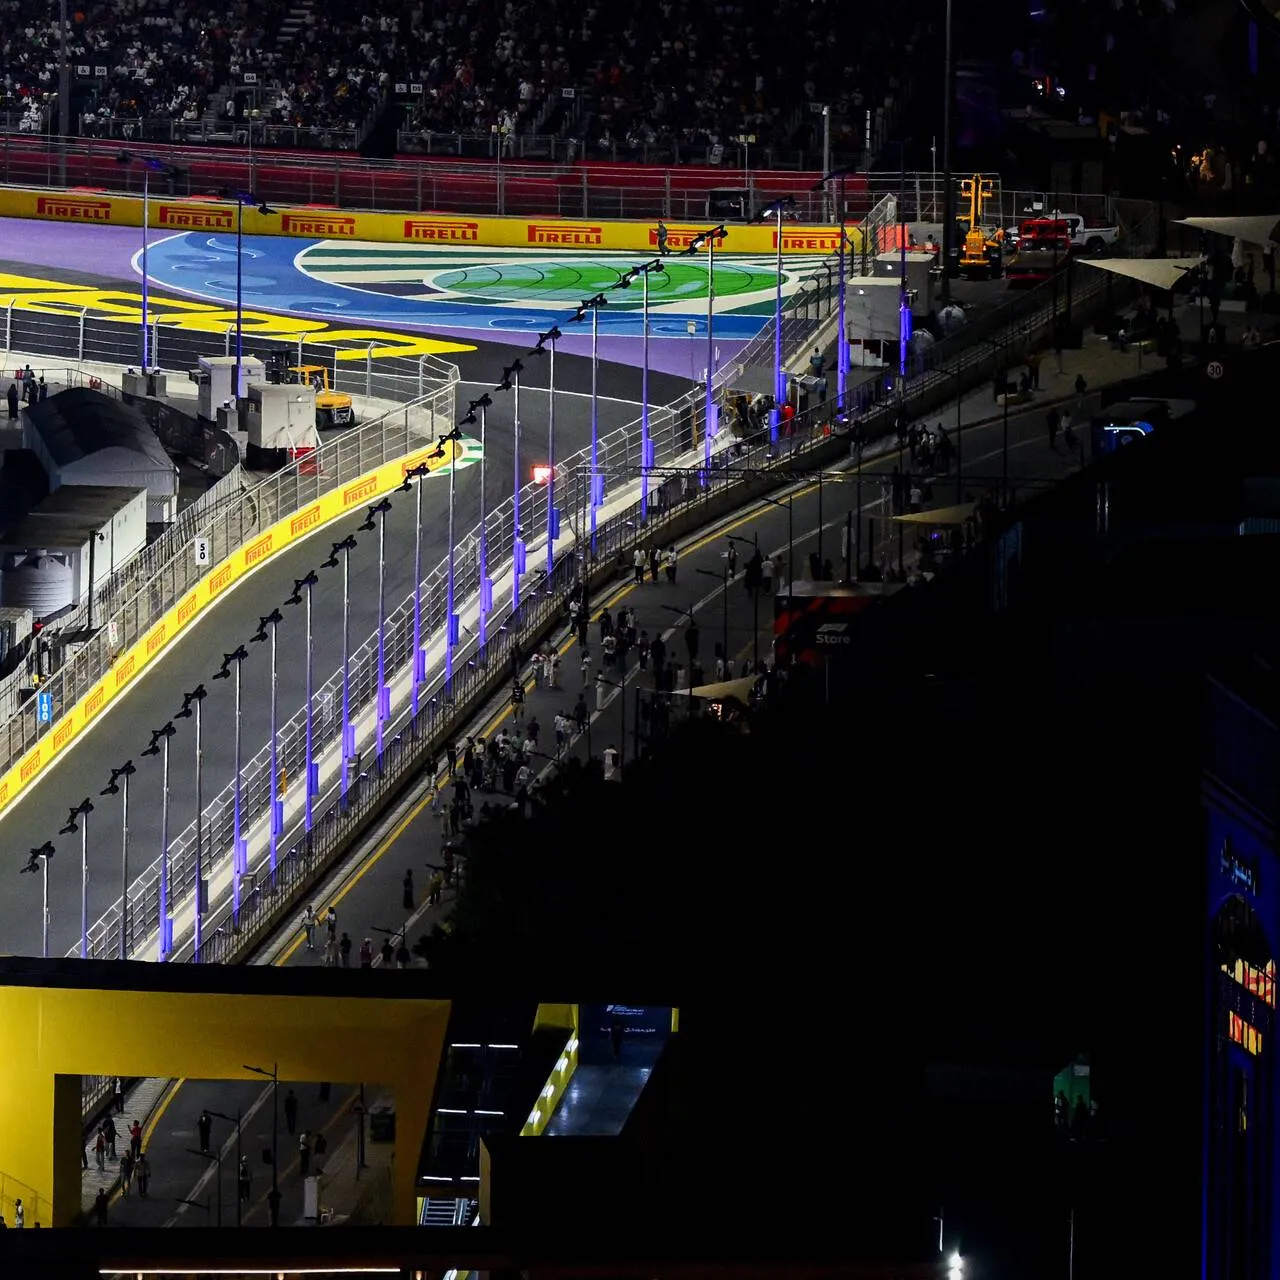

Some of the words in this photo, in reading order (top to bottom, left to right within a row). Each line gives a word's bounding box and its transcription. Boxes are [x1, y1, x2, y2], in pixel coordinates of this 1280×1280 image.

[35, 196, 111, 220] PIRELLI
[159, 206, 233, 229] PIRELLI
[281, 213, 355, 236] PIRELLI
[403, 219, 478, 241] PIRELLI
[527, 224, 602, 246] PIRELLI
[343, 475, 378, 506] PIRELLI
[290, 504, 321, 536] PIRELLI
[244, 533, 273, 566] PIRELLI
[209, 563, 231, 596] PIRELLI
[176, 593, 197, 625] PIRELLI
[815, 633, 851, 645] Store
